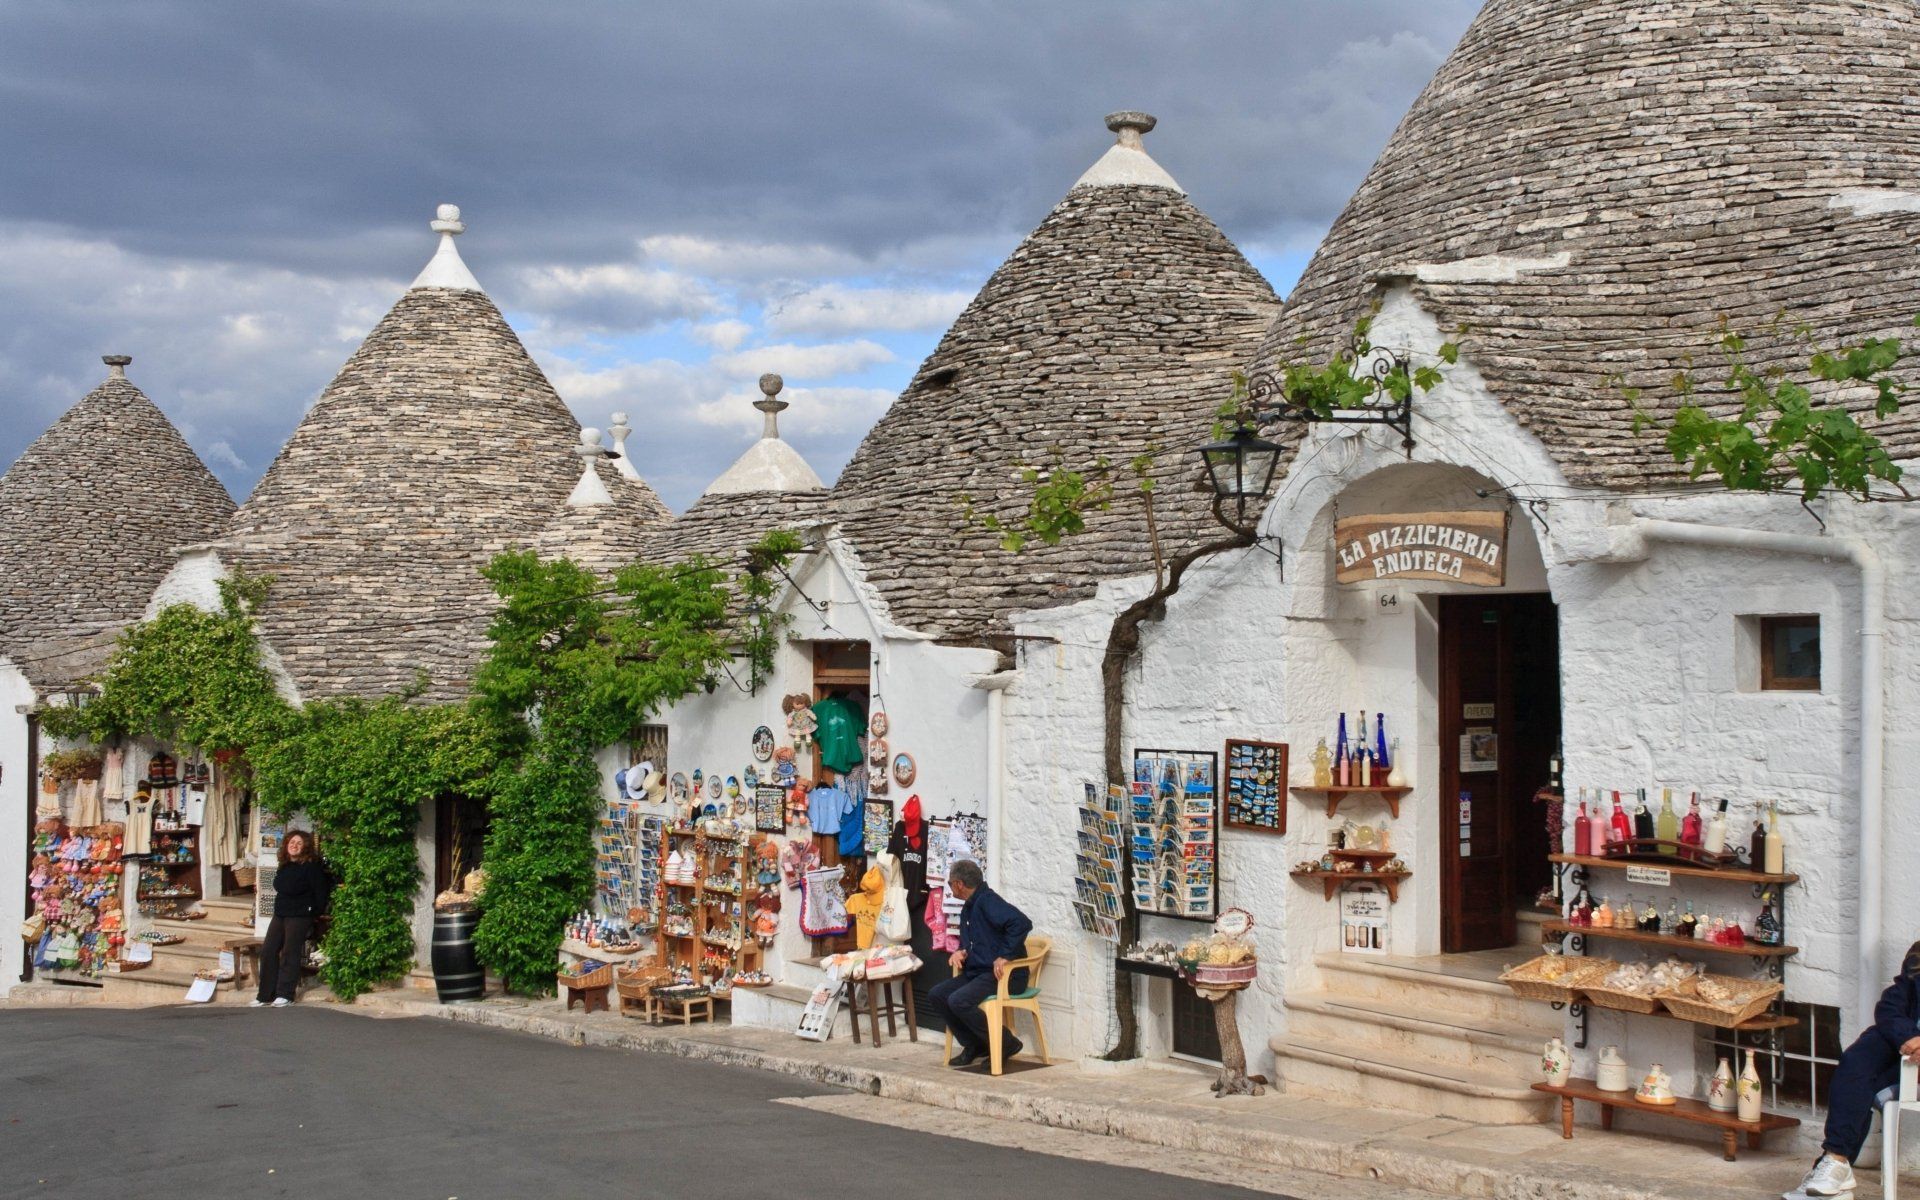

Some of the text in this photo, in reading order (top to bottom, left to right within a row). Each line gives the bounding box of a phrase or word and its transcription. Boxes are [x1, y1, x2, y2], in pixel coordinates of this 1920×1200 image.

[1340, 524, 1499, 568] LA PIZZICHERIA
[1372, 550, 1463, 578] ENOTECA
[1380, 594, 1397, 607] 64
